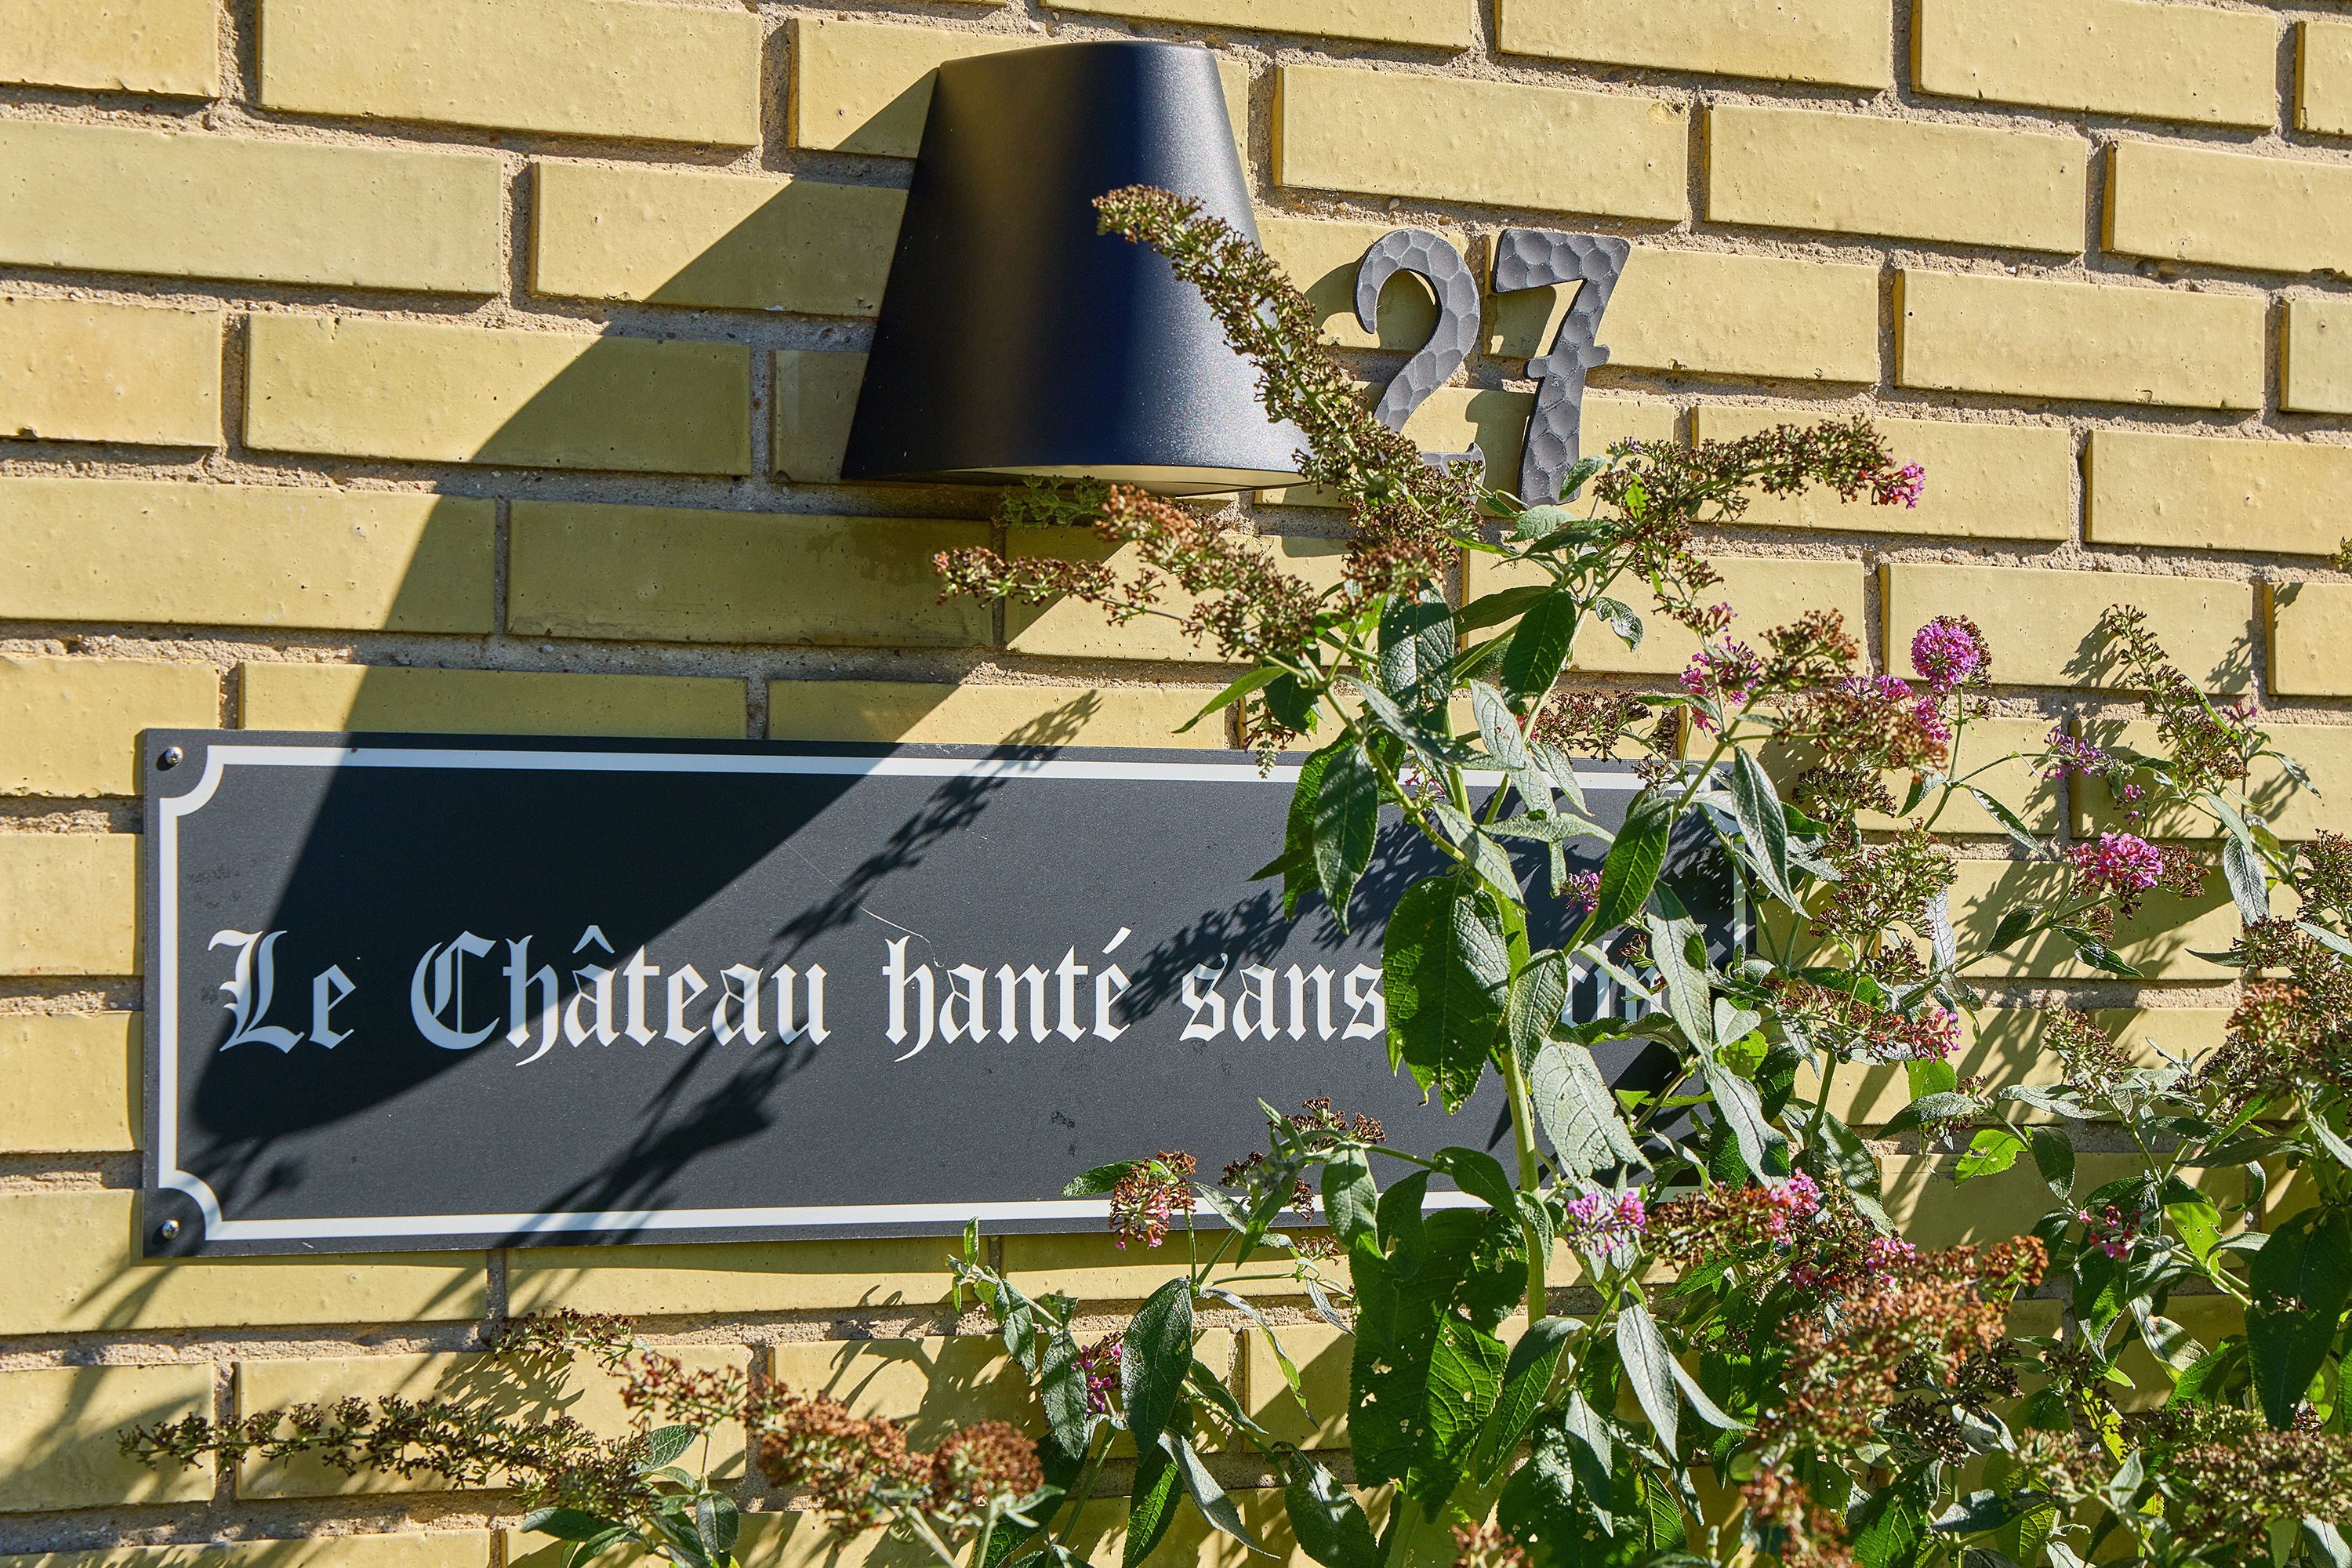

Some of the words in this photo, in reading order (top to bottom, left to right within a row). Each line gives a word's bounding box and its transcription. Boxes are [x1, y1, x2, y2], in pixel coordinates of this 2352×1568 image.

[1352, 227, 1631, 511] 27
[207, 929, 357, 1054] Le
[410, 924, 832, 1067] Château
[882, 926, 1133, 1063] hanté
[1178, 952, 1386, 1042] sans
